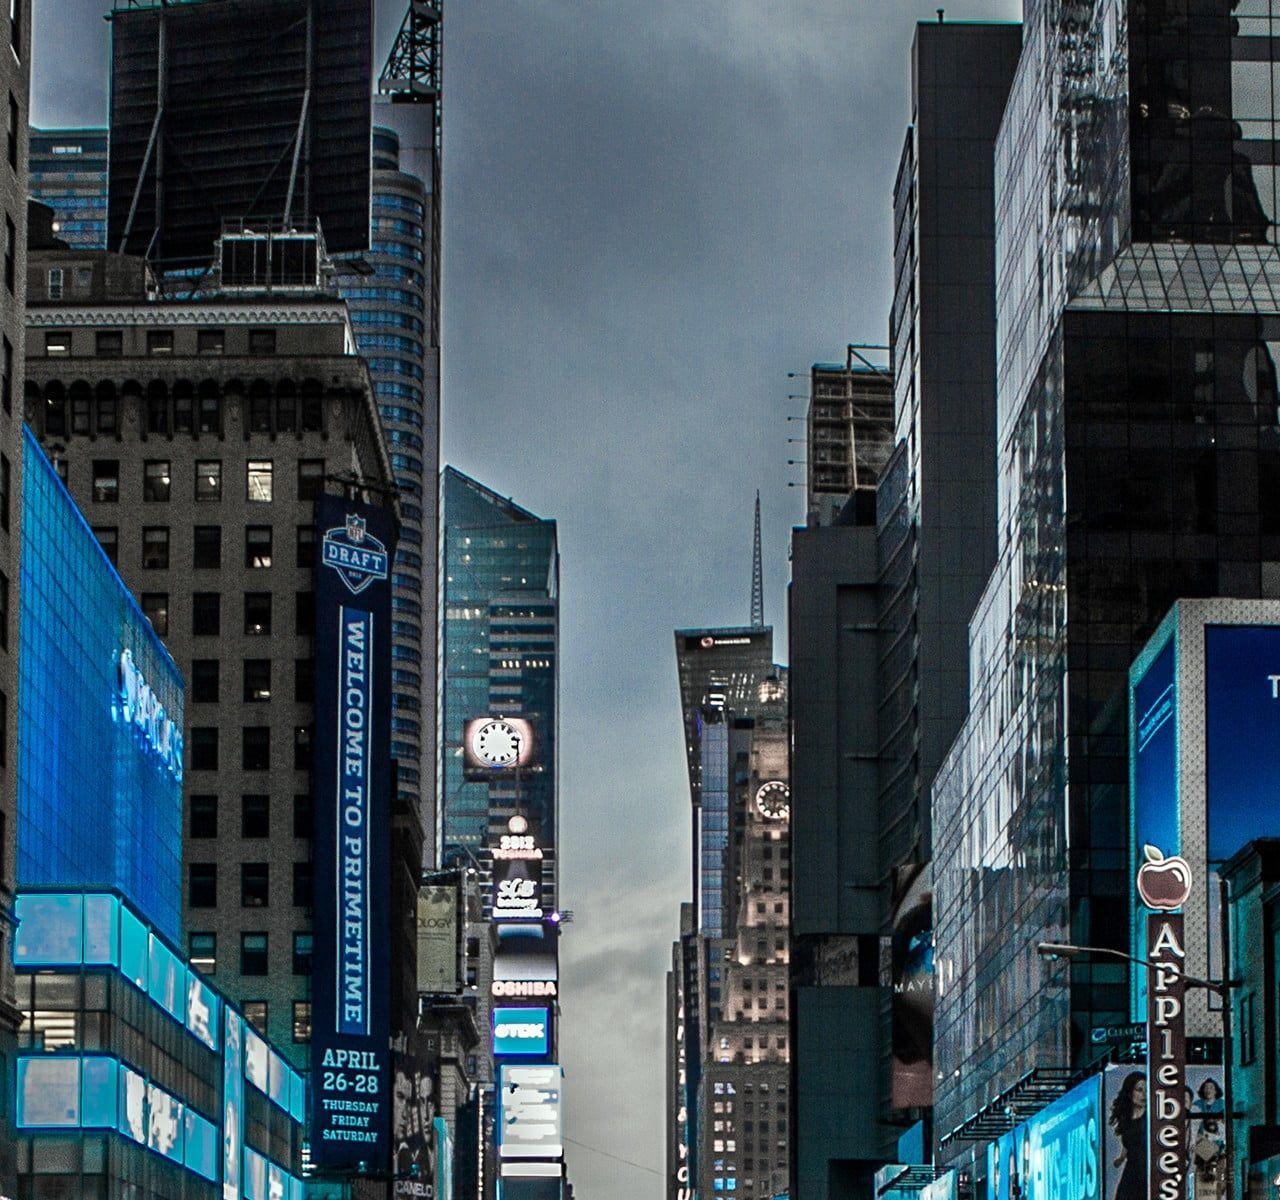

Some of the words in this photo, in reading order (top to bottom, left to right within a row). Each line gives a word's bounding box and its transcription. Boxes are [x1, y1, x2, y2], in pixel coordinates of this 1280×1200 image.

[328, 544, 382, 570] DRAFT
[346, 621, 366, 779] WELCOME
[345, 785, 362, 827] TO
[344, 834, 363, 1024] PRIMETIME
[492, 981, 557, 996] OSHIBA
[323, 1048, 379, 1070] APRIL
[1149, 922, 1185, 1200] Applebee's
[323, 1072, 378, 1093] 26-28
[323, 1099, 379, 1113] THURSDAY
[332, 1115, 370, 1127] FRIDAY
[323, 1129, 378, 1143] SATURDAY
